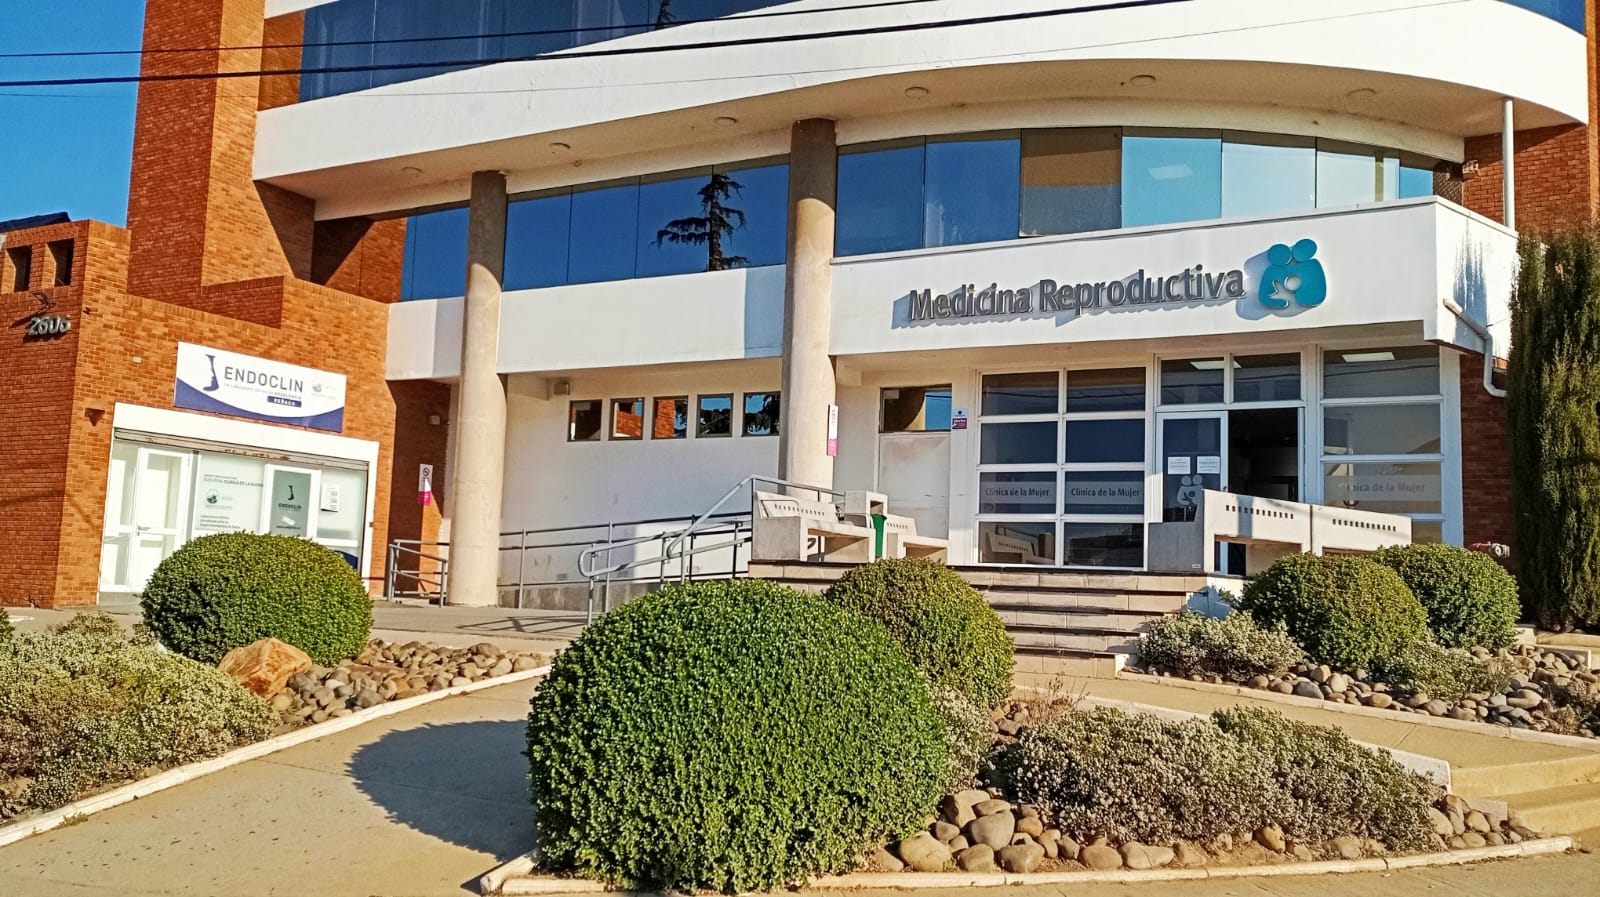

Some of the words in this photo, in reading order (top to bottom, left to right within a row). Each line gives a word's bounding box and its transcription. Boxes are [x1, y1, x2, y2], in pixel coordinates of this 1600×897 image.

[910, 283, 1033, 320] Medicina
[1039, 264, 1247, 316] Reproductiva
[224, 366, 303, 393] ENDOCLIN
[1010, 488, 1019, 496] de
[1020, 488, 1027, 496] la
[1028, 488, 1050, 498] Mujer
[1097, 488, 1107, 496] de
[1108, 488, 1116, 496] la
[1117, 488, 1140, 498] Mujer
[1372, 483, 1385, 492] de
[1386, 482, 1396, 492] la
[1397, 482, 1425, 494] Mujer
